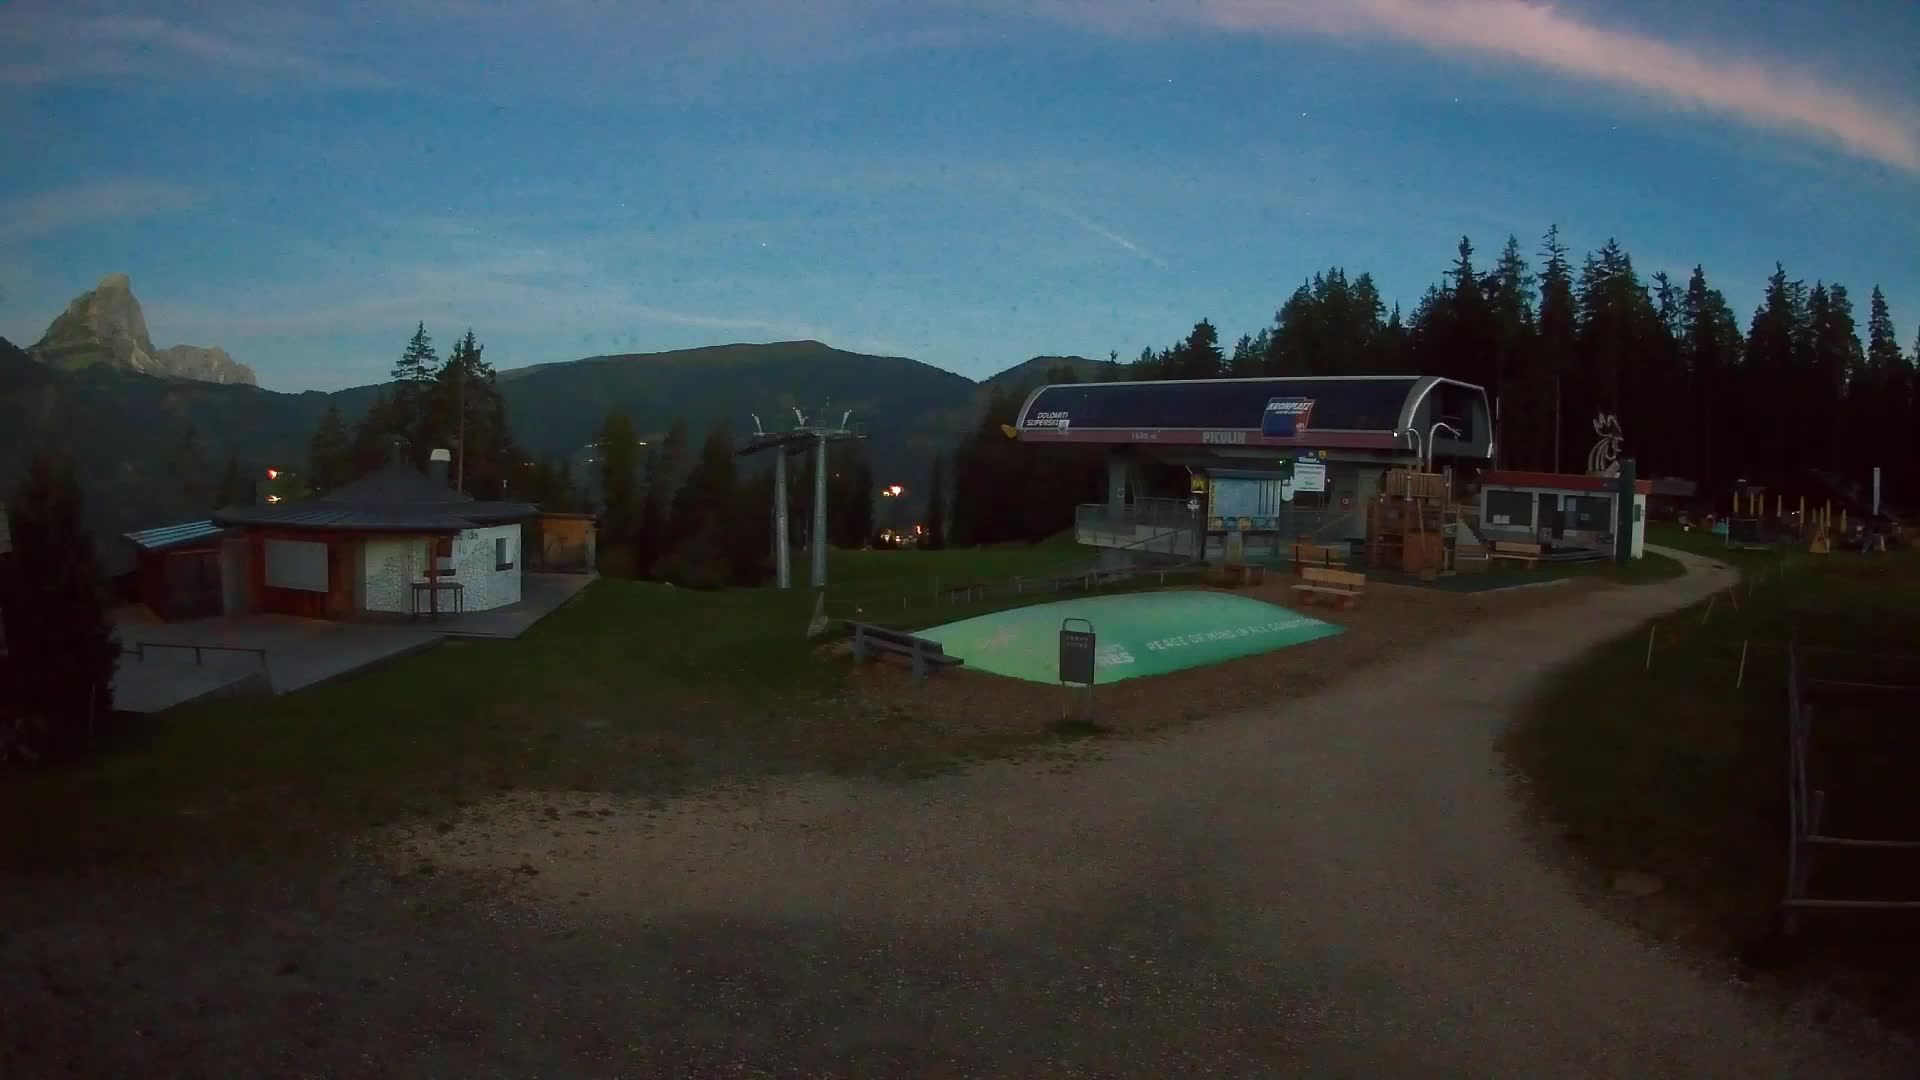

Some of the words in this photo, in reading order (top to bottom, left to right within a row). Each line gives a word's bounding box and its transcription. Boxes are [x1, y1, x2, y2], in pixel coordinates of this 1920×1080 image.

[1037, 411, 1069, 419] DOLOMITI
[1202, 431, 1246, 444] PICULIN
[1146, 637, 1188, 650] PEACE
[1188, 632, 1205, 644] OF
[1206, 630, 1236, 641] MIND
